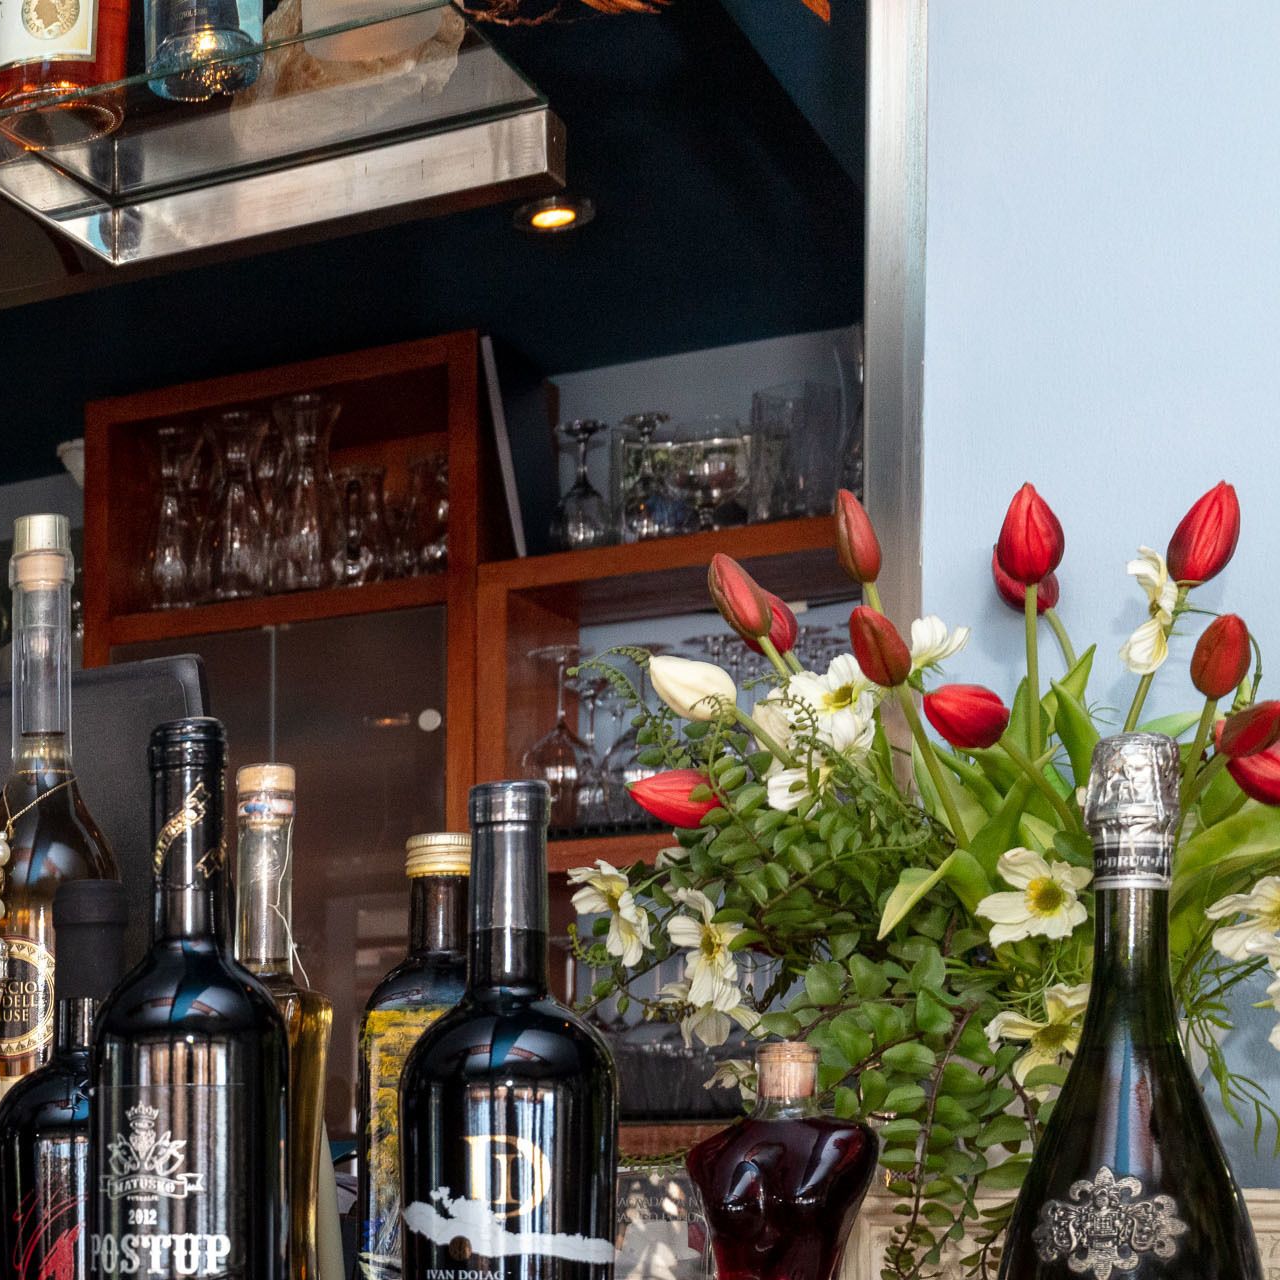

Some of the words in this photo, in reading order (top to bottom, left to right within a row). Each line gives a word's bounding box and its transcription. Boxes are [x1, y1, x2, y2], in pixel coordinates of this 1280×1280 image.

[1108, 856, 1150, 868] BRUT
[4, 981, 38, 994] CIO
[128, 1208, 158, 1225] 2012
[90, 1232, 231, 1275] POSTUP
[426, 1270, 454, 1280] IVAN
